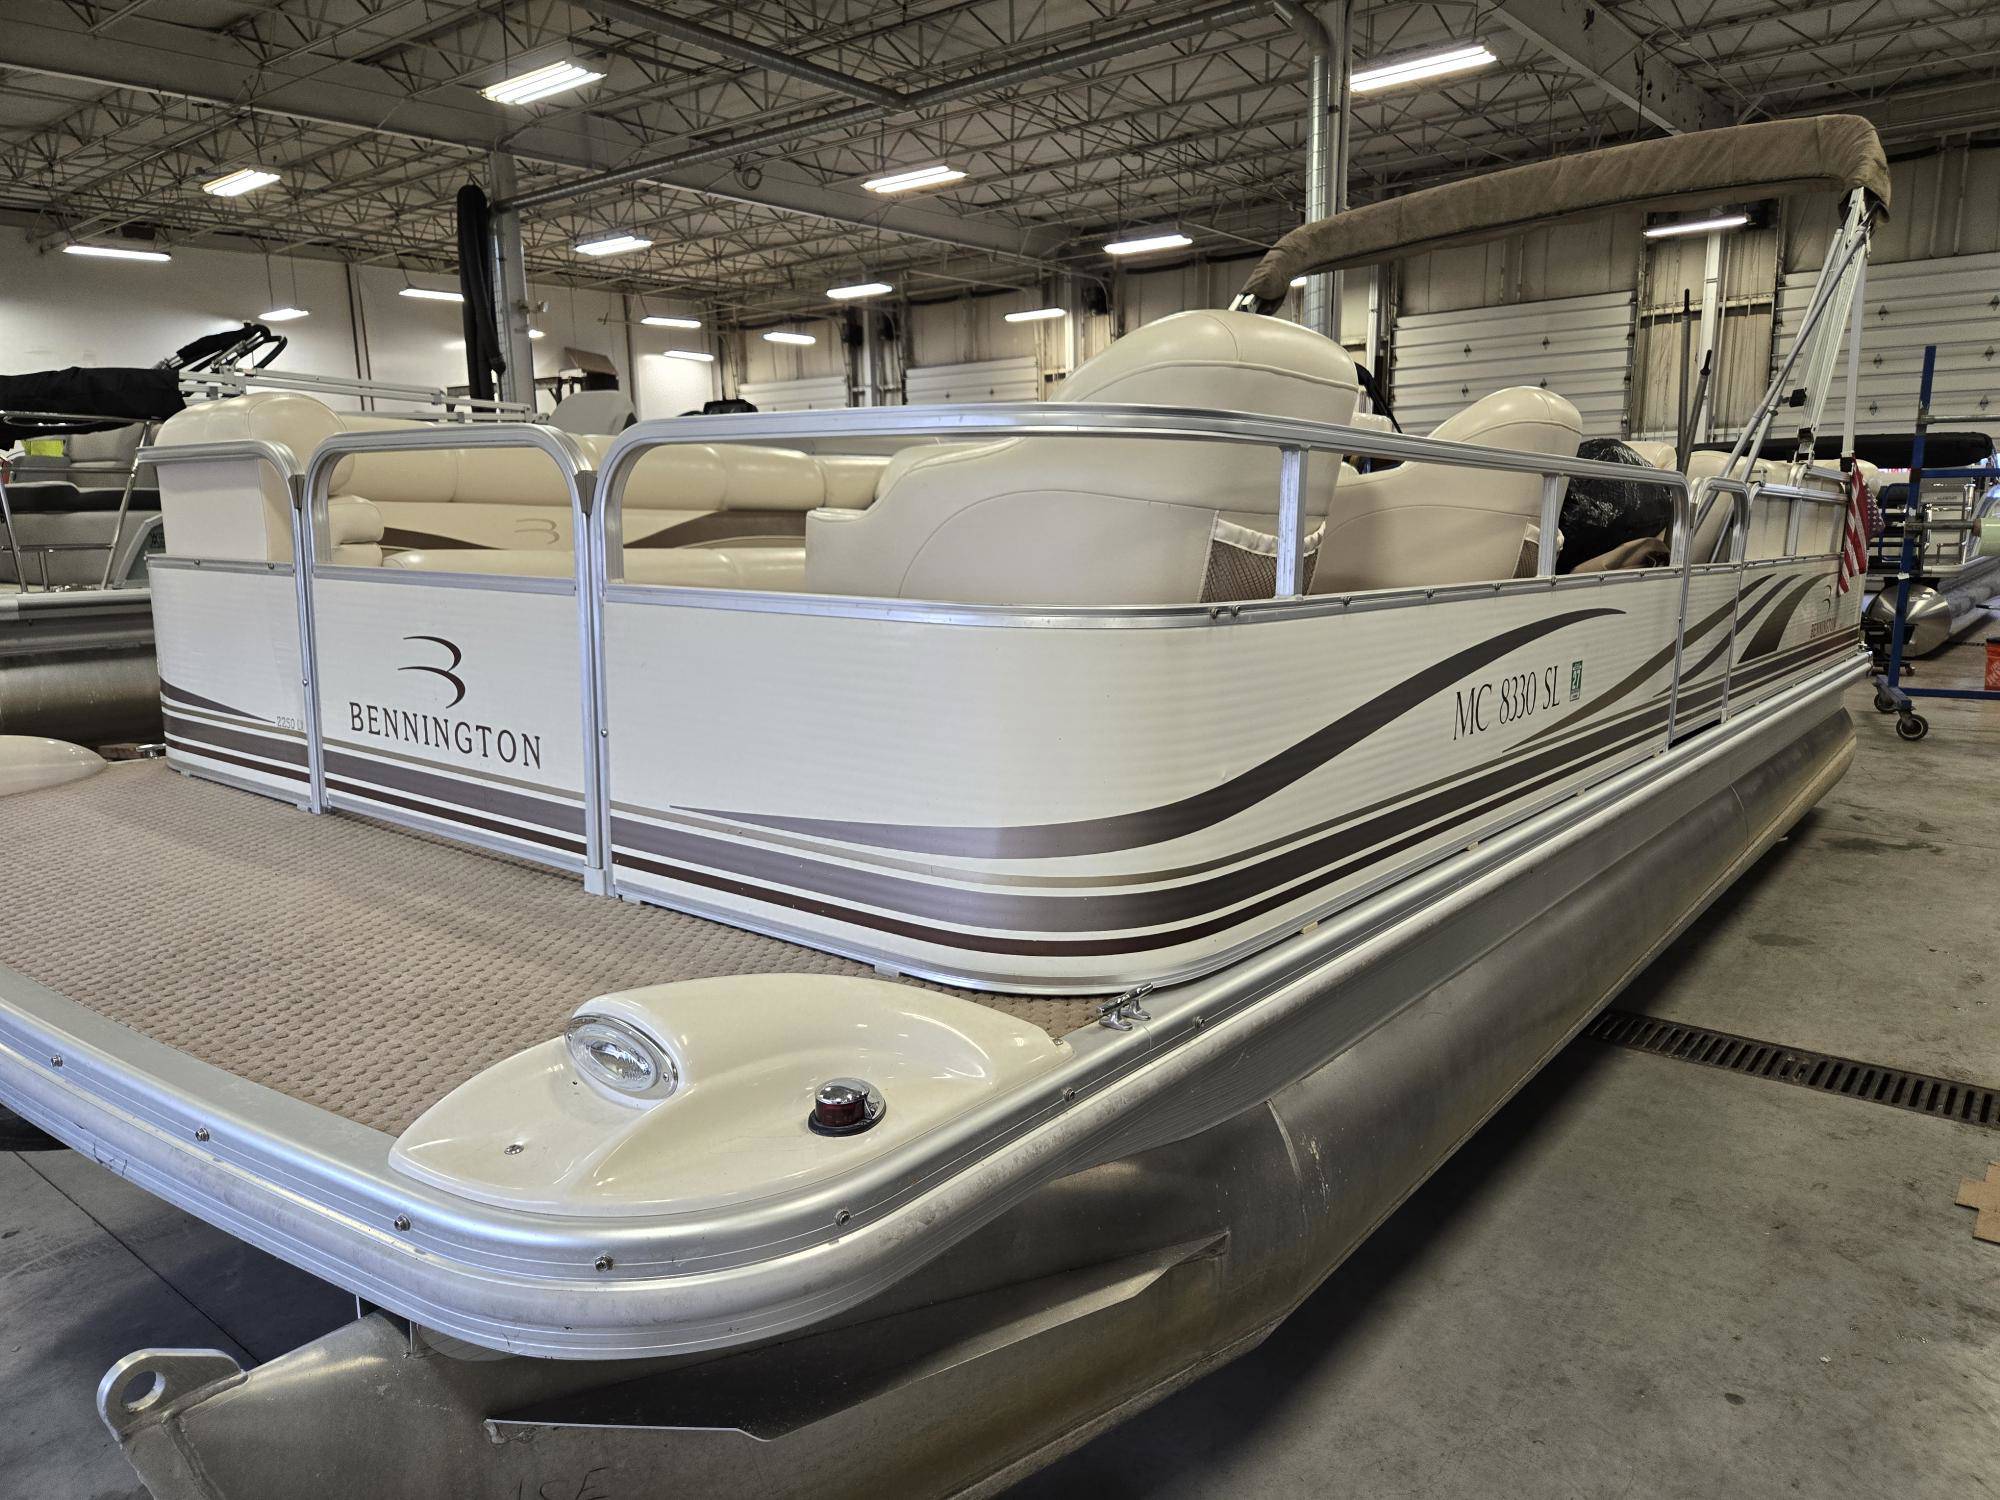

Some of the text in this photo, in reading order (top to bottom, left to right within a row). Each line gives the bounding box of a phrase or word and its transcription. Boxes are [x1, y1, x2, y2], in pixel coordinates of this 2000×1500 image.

[276, 715, 296, 730] 2250
[349, 701, 541, 770] BENNINGTON
[1453, 665, 1560, 741] MC 8330 SL
